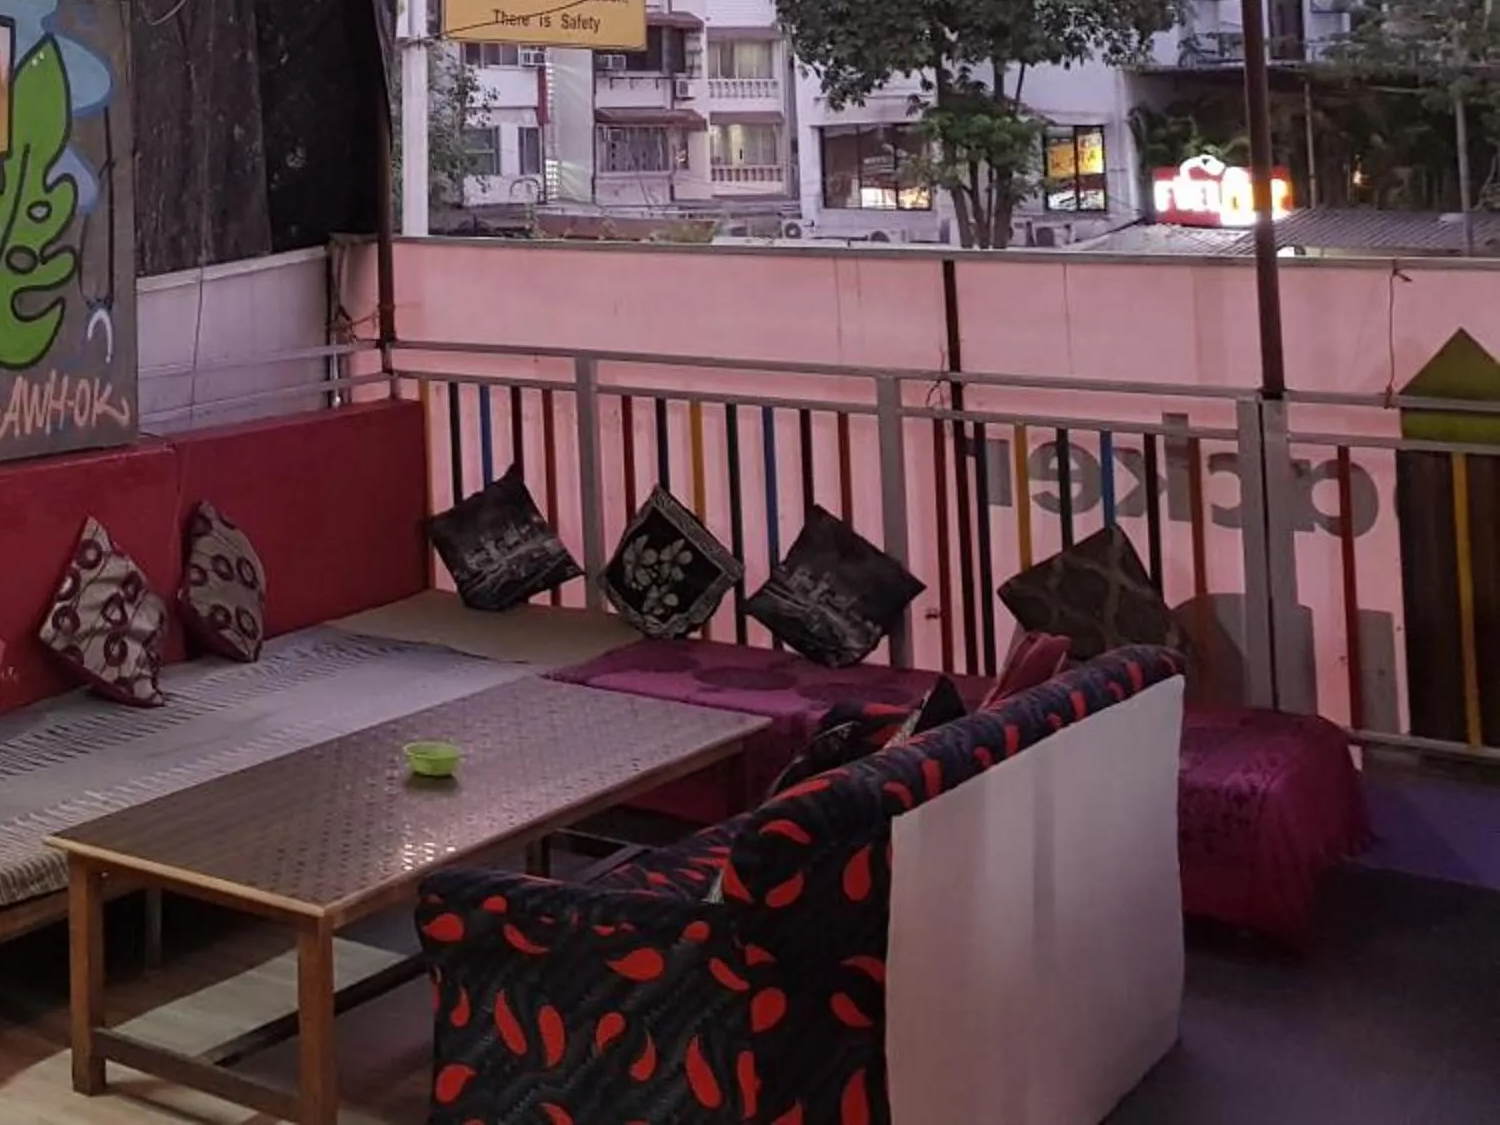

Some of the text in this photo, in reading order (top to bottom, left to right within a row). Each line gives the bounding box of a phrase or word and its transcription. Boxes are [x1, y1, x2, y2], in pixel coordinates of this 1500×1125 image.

[493, 8, 601, 34] There is Safety
